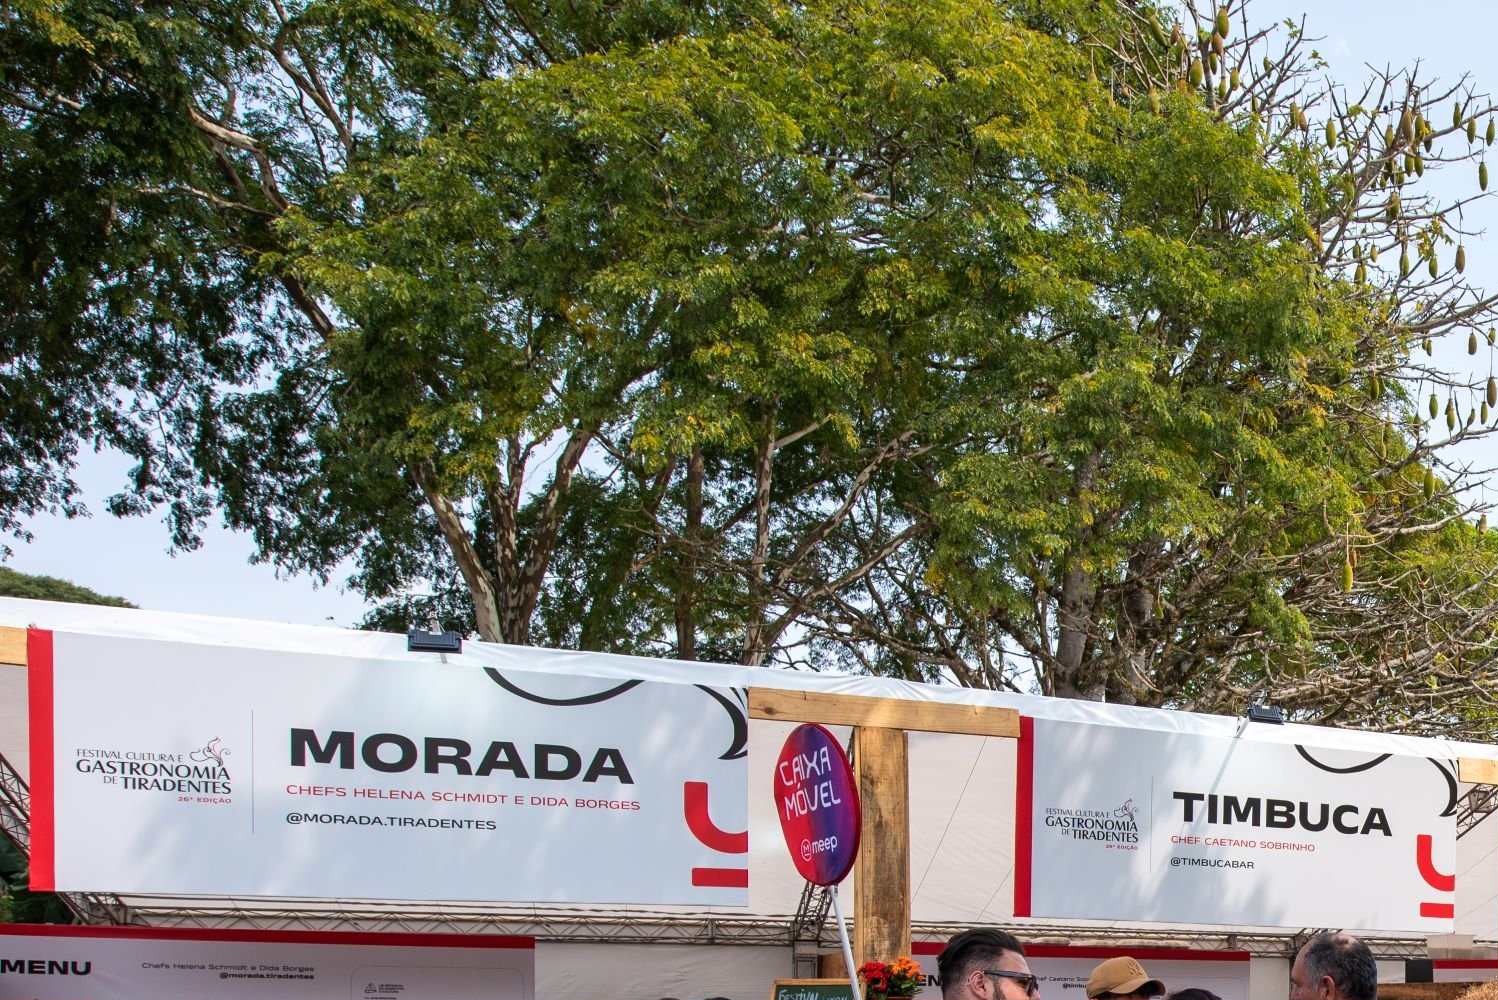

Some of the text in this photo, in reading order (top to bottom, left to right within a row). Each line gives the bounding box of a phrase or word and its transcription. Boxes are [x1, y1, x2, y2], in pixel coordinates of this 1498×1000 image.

[76, 748, 184, 763] FESTIVAL CULTURA E
[290, 727, 636, 785] MORADA
[76, 758, 231, 781] GASTRONOMIA
[779, 746, 832, 786] CAIXA
[103, 775, 232, 795] DE TIRADENTES
[196, 796, 232, 804] EDIÇÃO
[286, 784, 641, 812] CHEFS HELENA SCHMIDT E DIDA BORGES
[784, 780, 841, 820] MÓVEL
[285, 812, 497, 831] @MORADA.TIRADENTES
[1046, 808, 1073, 817] FESTIVAL
[1075, 809, 1105, 818] CULTURA
[1172, 791, 1393, 837] TIMBUCA
[1045, 815, 1138, 832] GASTRONOMIA
[812, 835, 838, 854] meep
[1072, 829, 1138, 843] TIRADENTES
[1171, 835, 1315, 852] CHEF CAETANO SOBRINHO
[1170, 856, 1254, 869] @TIMBUCABAR
[0, 959, 92, 976] MENU
[142, 962, 170, 970] Chefs
[208, 963, 248, 971] Schmidt
[283, 965, 315, 973] Borges
[220, 972, 315, 980] @morada.tiradentes
